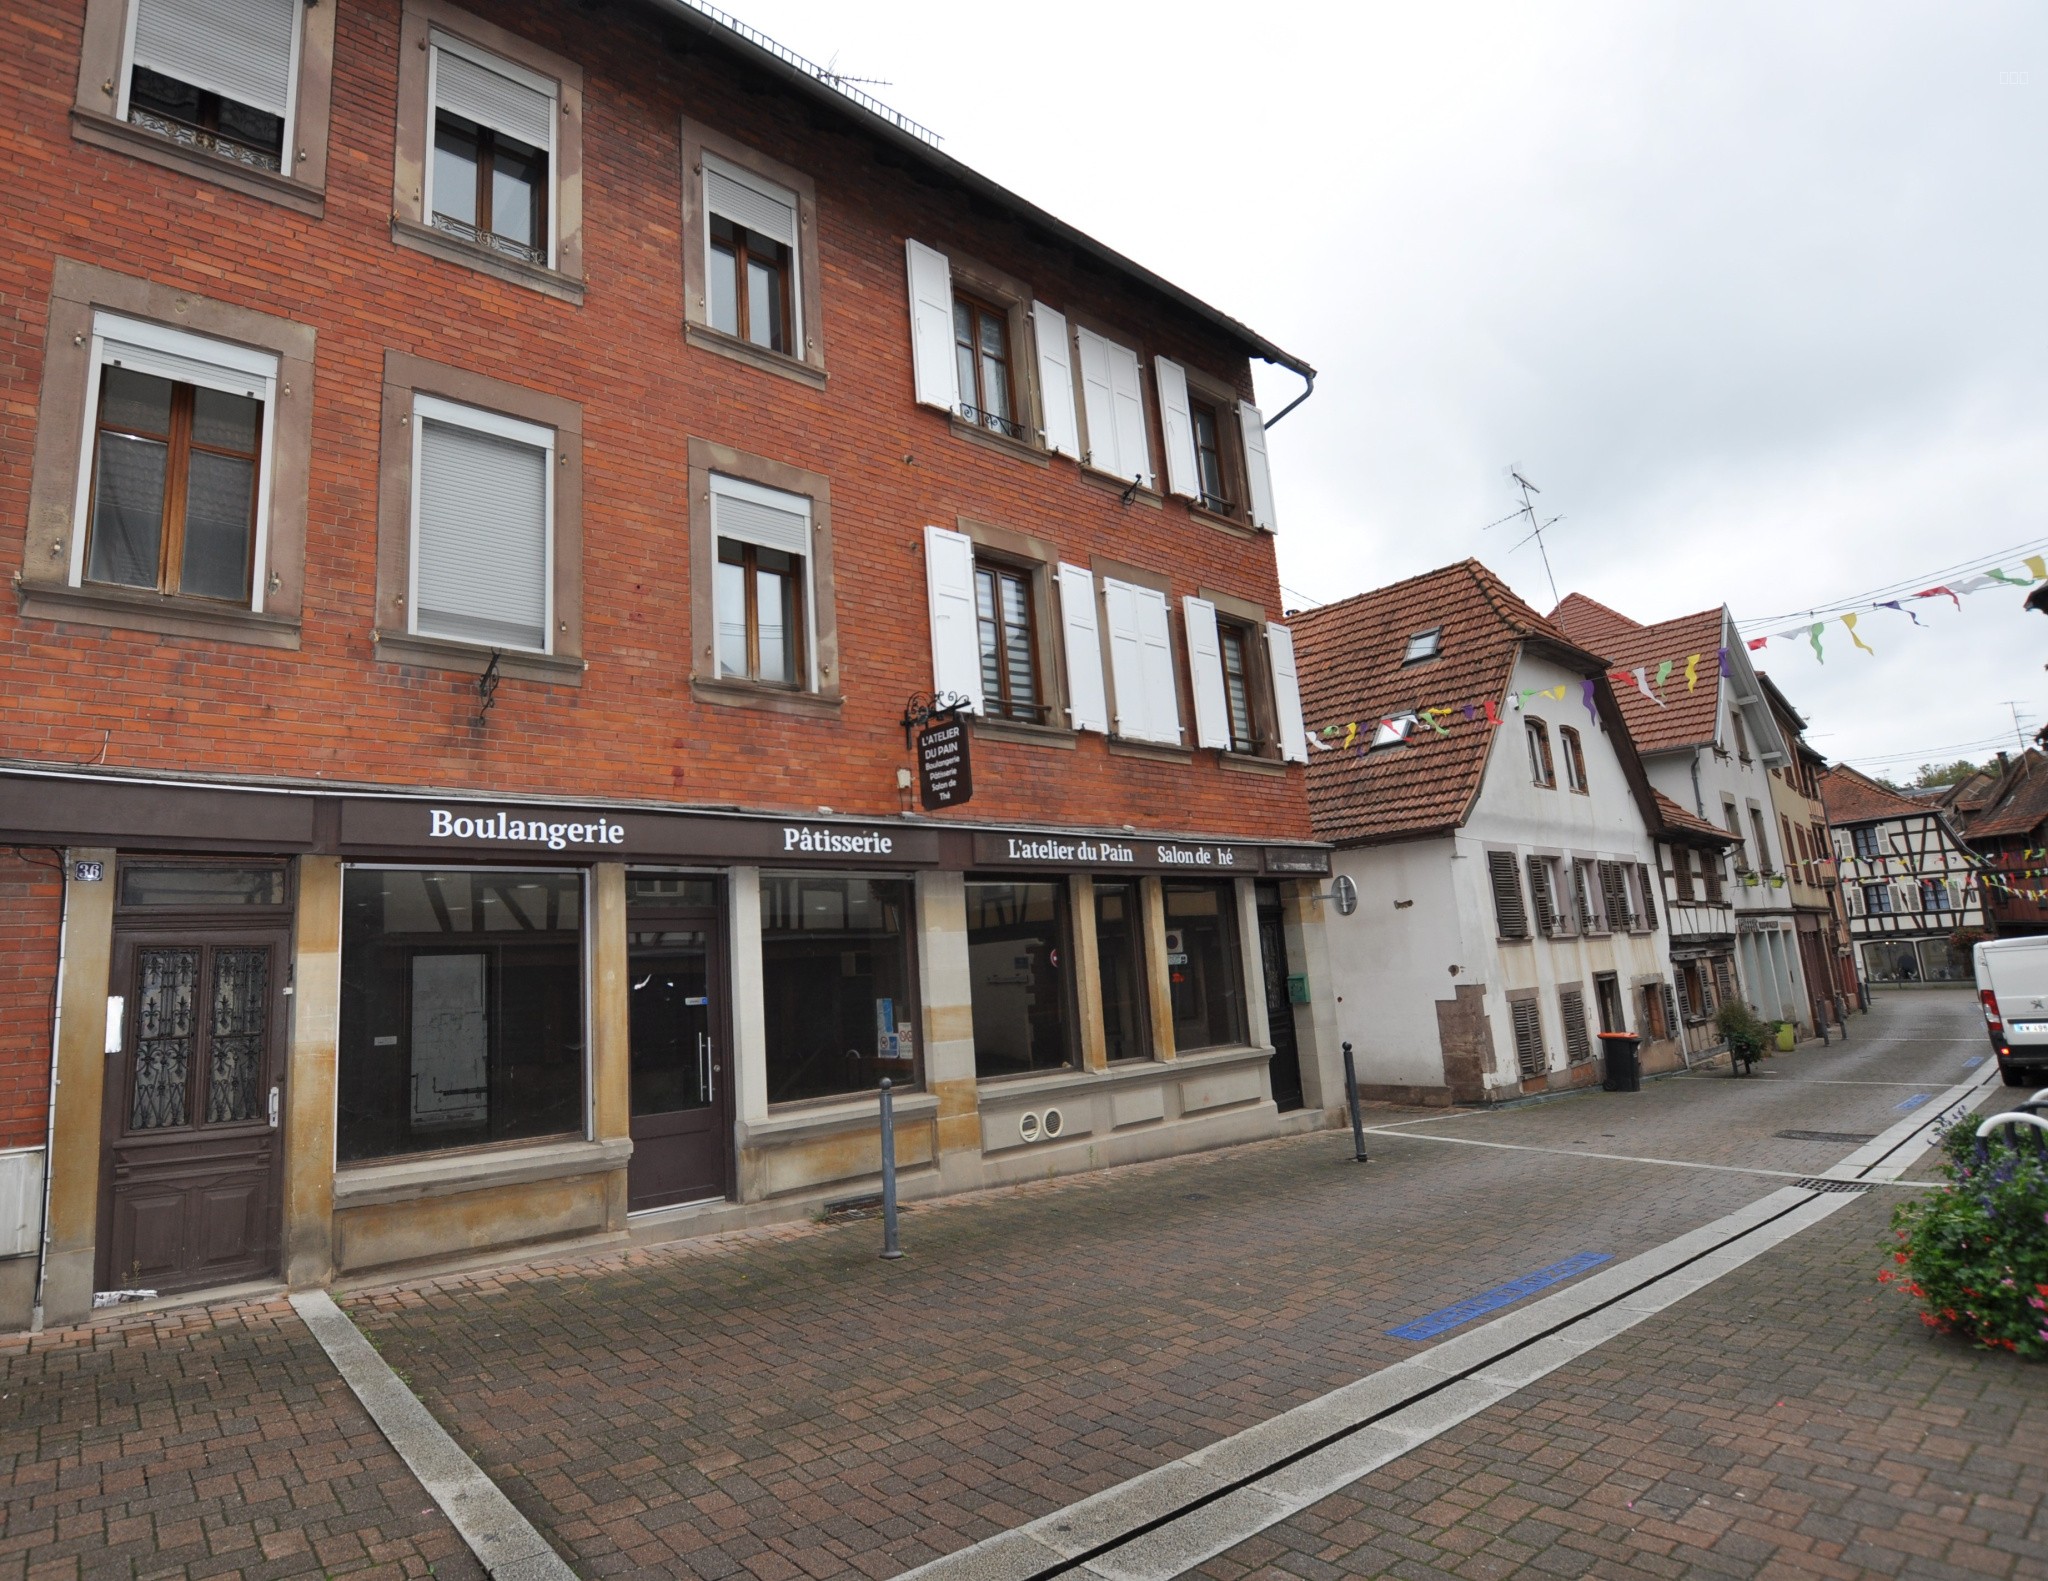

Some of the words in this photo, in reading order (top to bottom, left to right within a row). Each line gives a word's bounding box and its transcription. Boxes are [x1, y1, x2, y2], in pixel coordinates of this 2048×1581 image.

[922, 727, 959, 746] L'ATELIER
[925, 748, 937, 760] DU
[938, 742, 958, 756] PAIN
[925, 755, 960, 771] Boulangerie
[932, 783, 948, 792] Salon
[948, 779, 956, 787] de
[430, 809, 625, 850] Boulangerie
[783, 826, 893, 854] Pâtisserie
[1008, 838, 1075, 860] L'atelier
[1077, 841, 1098, 861] du
[1099, 843, 1134, 862] Pain
[1157, 845, 1195, 864] Salon
[1195, 846, 1211, 865] de
[79, 864, 100, 878] 36
